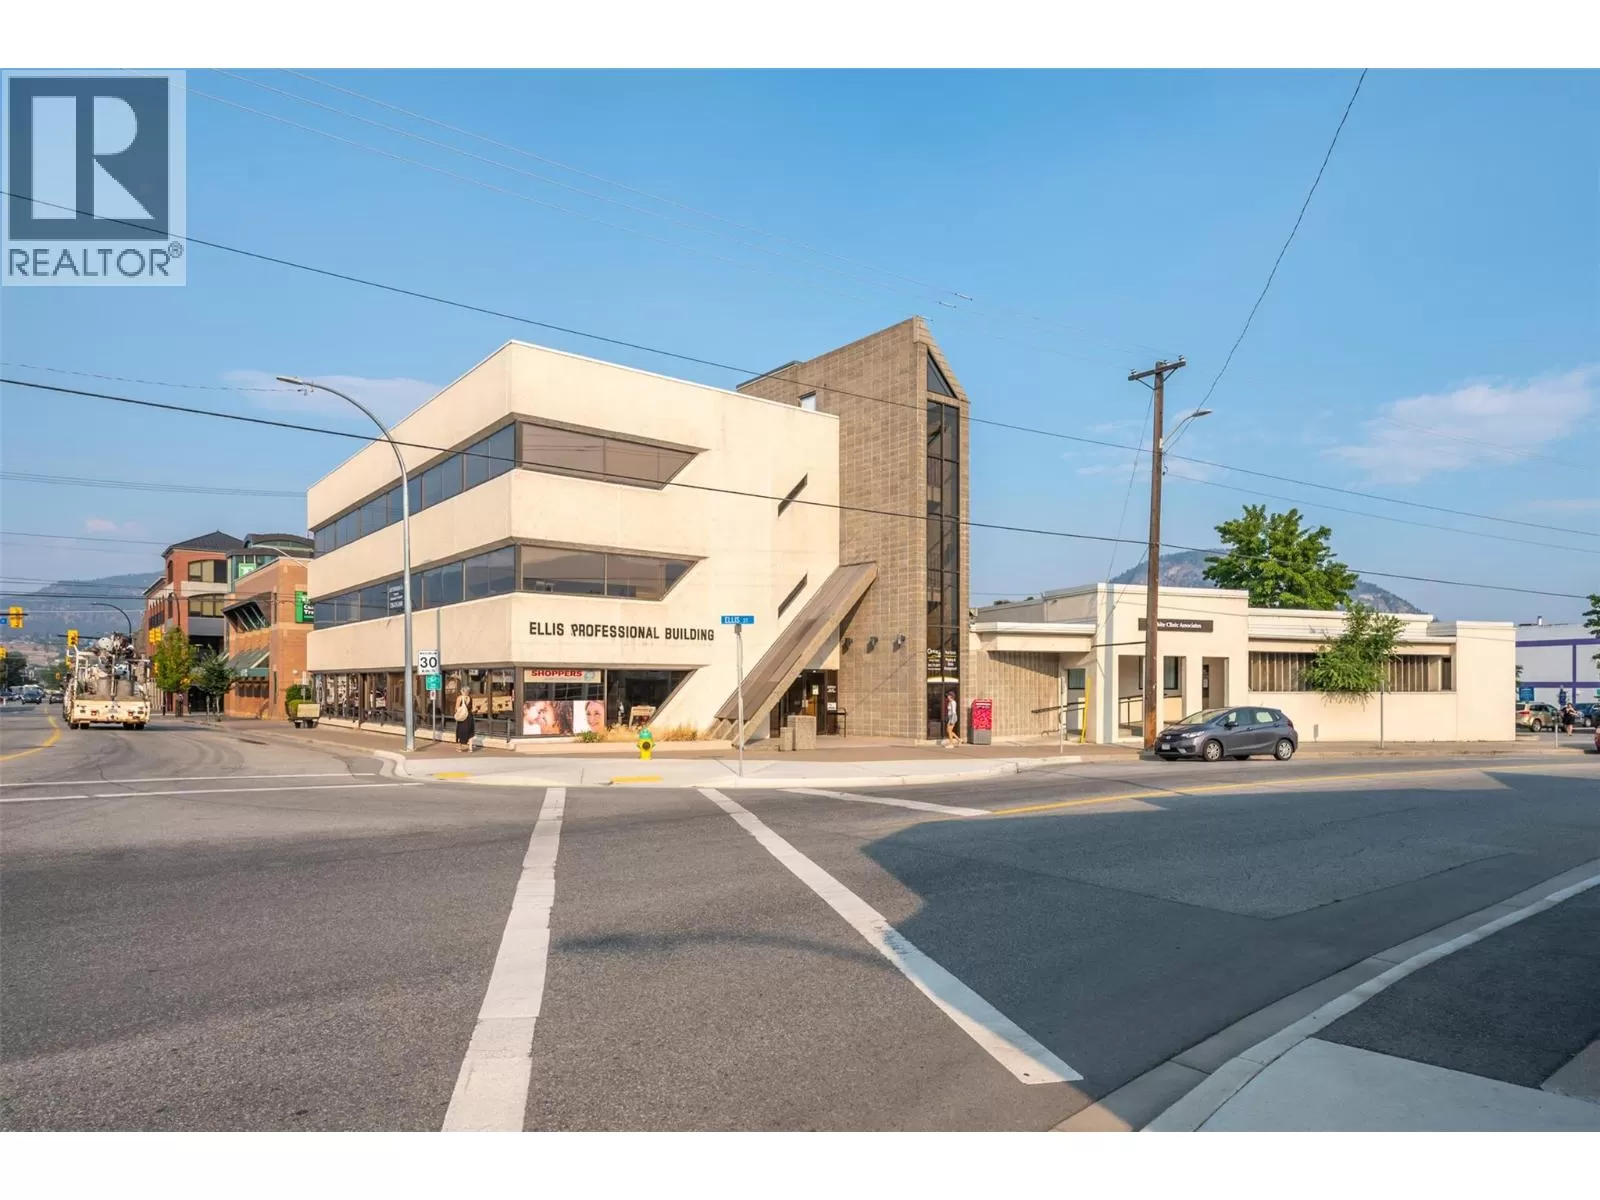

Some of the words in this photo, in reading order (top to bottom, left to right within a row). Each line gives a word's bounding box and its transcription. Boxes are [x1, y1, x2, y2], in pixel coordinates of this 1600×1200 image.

[724, 616, 740, 624] ELLIS
[529, 621, 564, 636] ELLIS
[571, 623, 660, 640] PROFESSIONAL
[664, 627, 715, 641] BUILDING
[420, 656, 438, 669] 30
[531, 669, 583, 677] SHOPPERS
